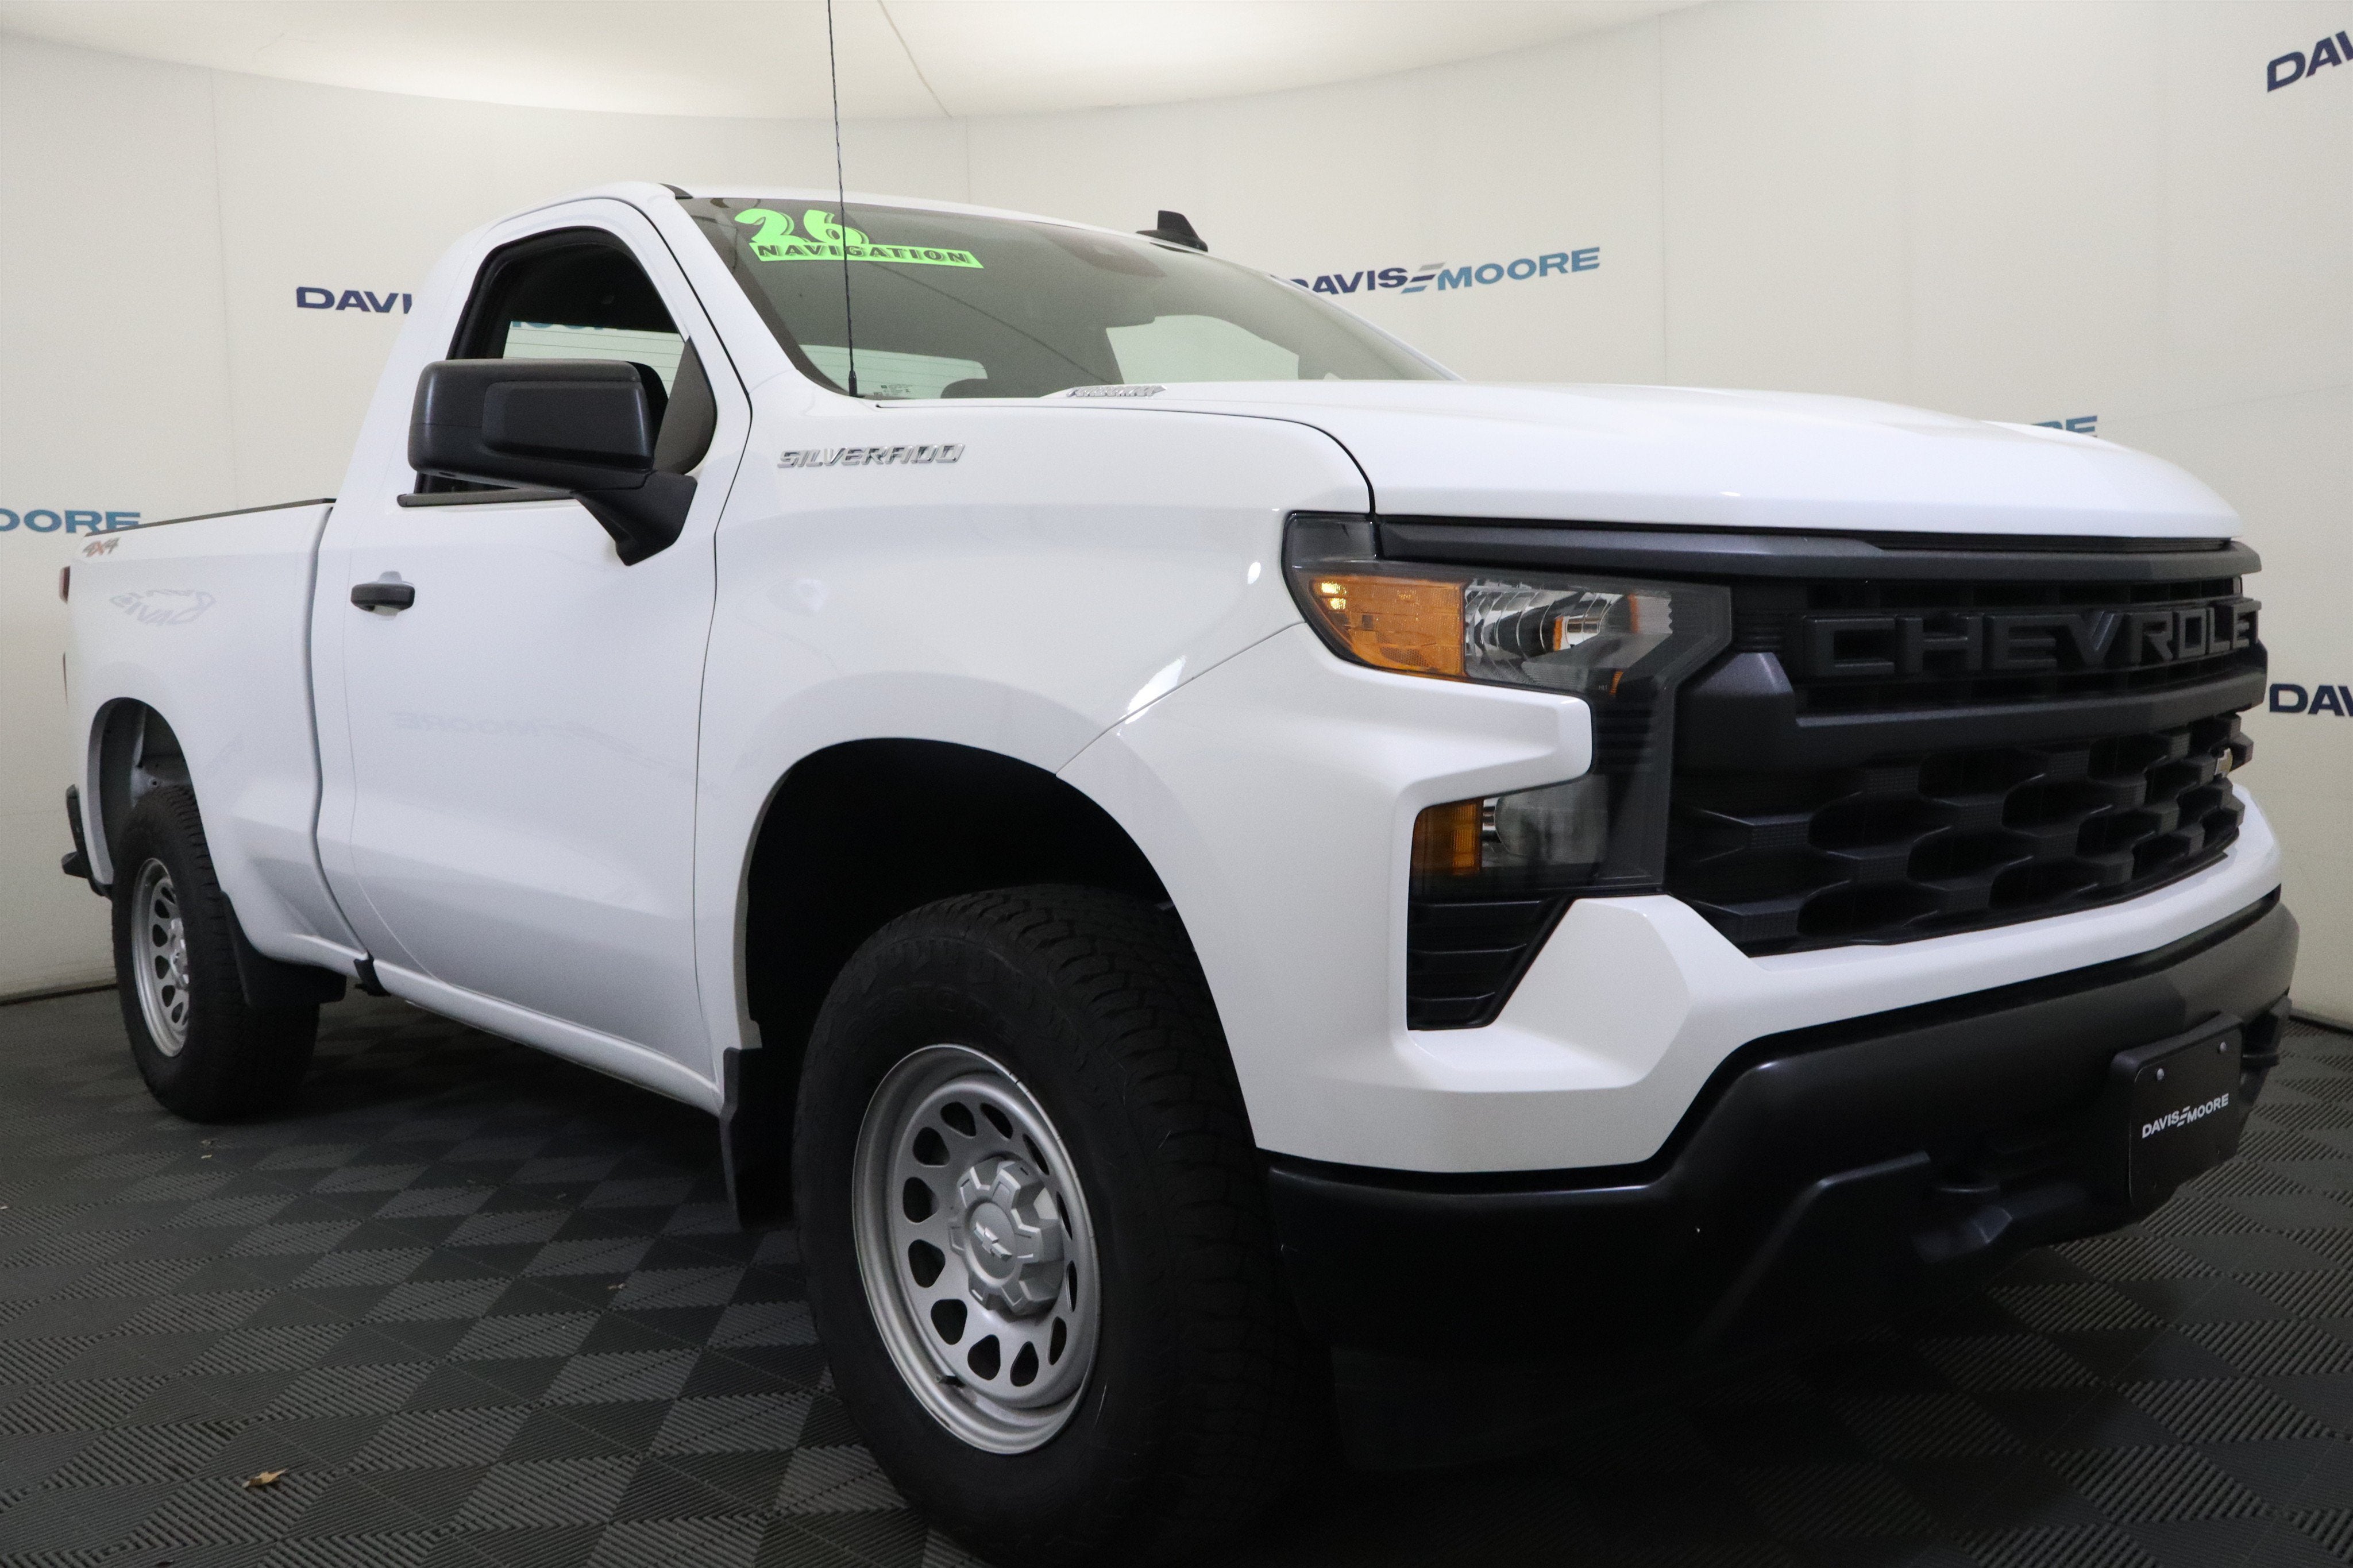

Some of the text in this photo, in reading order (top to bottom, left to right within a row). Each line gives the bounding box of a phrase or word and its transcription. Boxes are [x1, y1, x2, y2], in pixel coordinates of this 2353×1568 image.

[734, 208, 869, 244] 26
[757, 244, 971, 264] NAVIGATION
[1437, 246, 1600, 291] MOORE
[777, 443, 966, 469] SILVERADO
[2142, 1092, 2229, 1139] DAVIS MOORE
